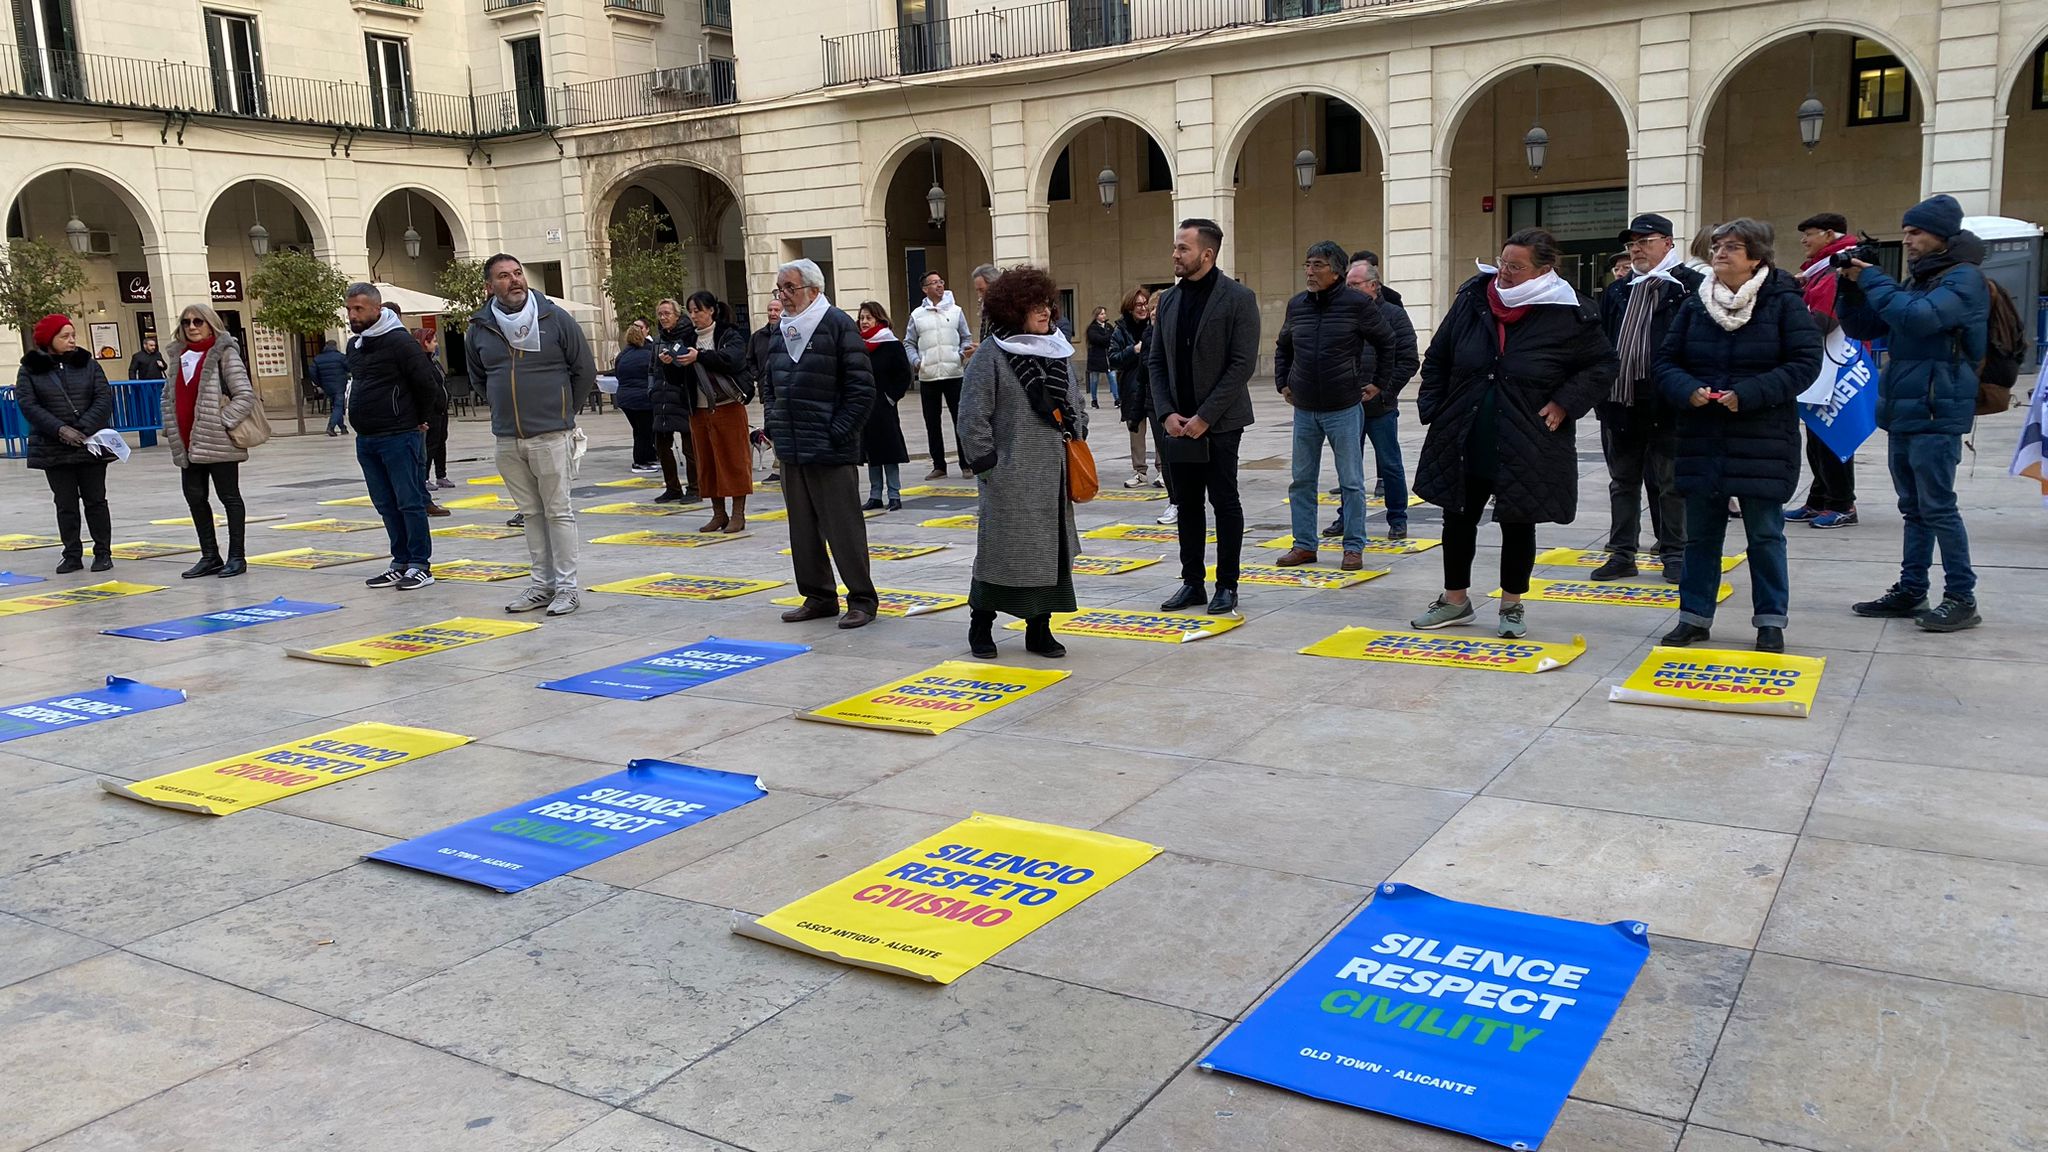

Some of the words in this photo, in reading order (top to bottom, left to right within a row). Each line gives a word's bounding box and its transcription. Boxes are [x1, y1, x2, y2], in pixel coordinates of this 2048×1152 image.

[225, 280, 236, 293] 2
[1816, 360, 1871, 428] SILENCE
[1062, 622, 1182, 635] CIVISMO
[1069, 616, 1201, 630] RESPETO
[1085, 612, 1215, 626] SILENCIO
[1366, 640, 1534, 658] RESPETO
[1379, 635, 1544, 652] SILENCIO
[643, 657, 742, 672] RESPECT
[674, 650, 766, 664] SILENCE
[1364, 647, 1518, 664] CIVISMO
[1654, 670, 1796, 687] RESPETO
[1661, 662, 1801, 678] SILENCIO
[890, 685, 1003, 702] RESPETO
[914, 676, 1027, 693] SILENCIO
[1653, 679, 1786, 696] CIVISMO
[47, 697, 133, 715] SILENCE
[870, 695, 975, 712] CIVISMO
[1, 705, 91, 725] RESPECT
[298, 739, 409, 762] SILENCIO
[254, 750, 366, 775] RESPETO
[214, 763, 319, 787] CIVISMO
[577, 787, 706, 818] SILENCE
[528, 800, 667, 834] RESPECT
[491, 818, 620, 849] CIVILITY
[437, 847, 456, 855] OLD
[457, 850, 479, 861] TOWN
[480, 857, 524, 871] ALICANTE
[924, 844, 1095, 885] SILENCIO
[885, 861, 1058, 906] RESPETO
[852, 884, 1013, 928] CIVISMO
[796, 920, 833, 934] CASCO
[831, 927, 881, 945] ANTIGUO
[884, 941, 943, 960] ALICANTE
[1370, 933, 1591, 990] SILENCE
[1335, 956, 1577, 1021] RESPECT
[1320, 989, 1545, 1053] CIVILITY
[1299, 1047, 1332, 1061] OLD
[1334, 1055, 1383, 1074] TOWN
[1393, 1069, 1477, 1096] ALICANTE
